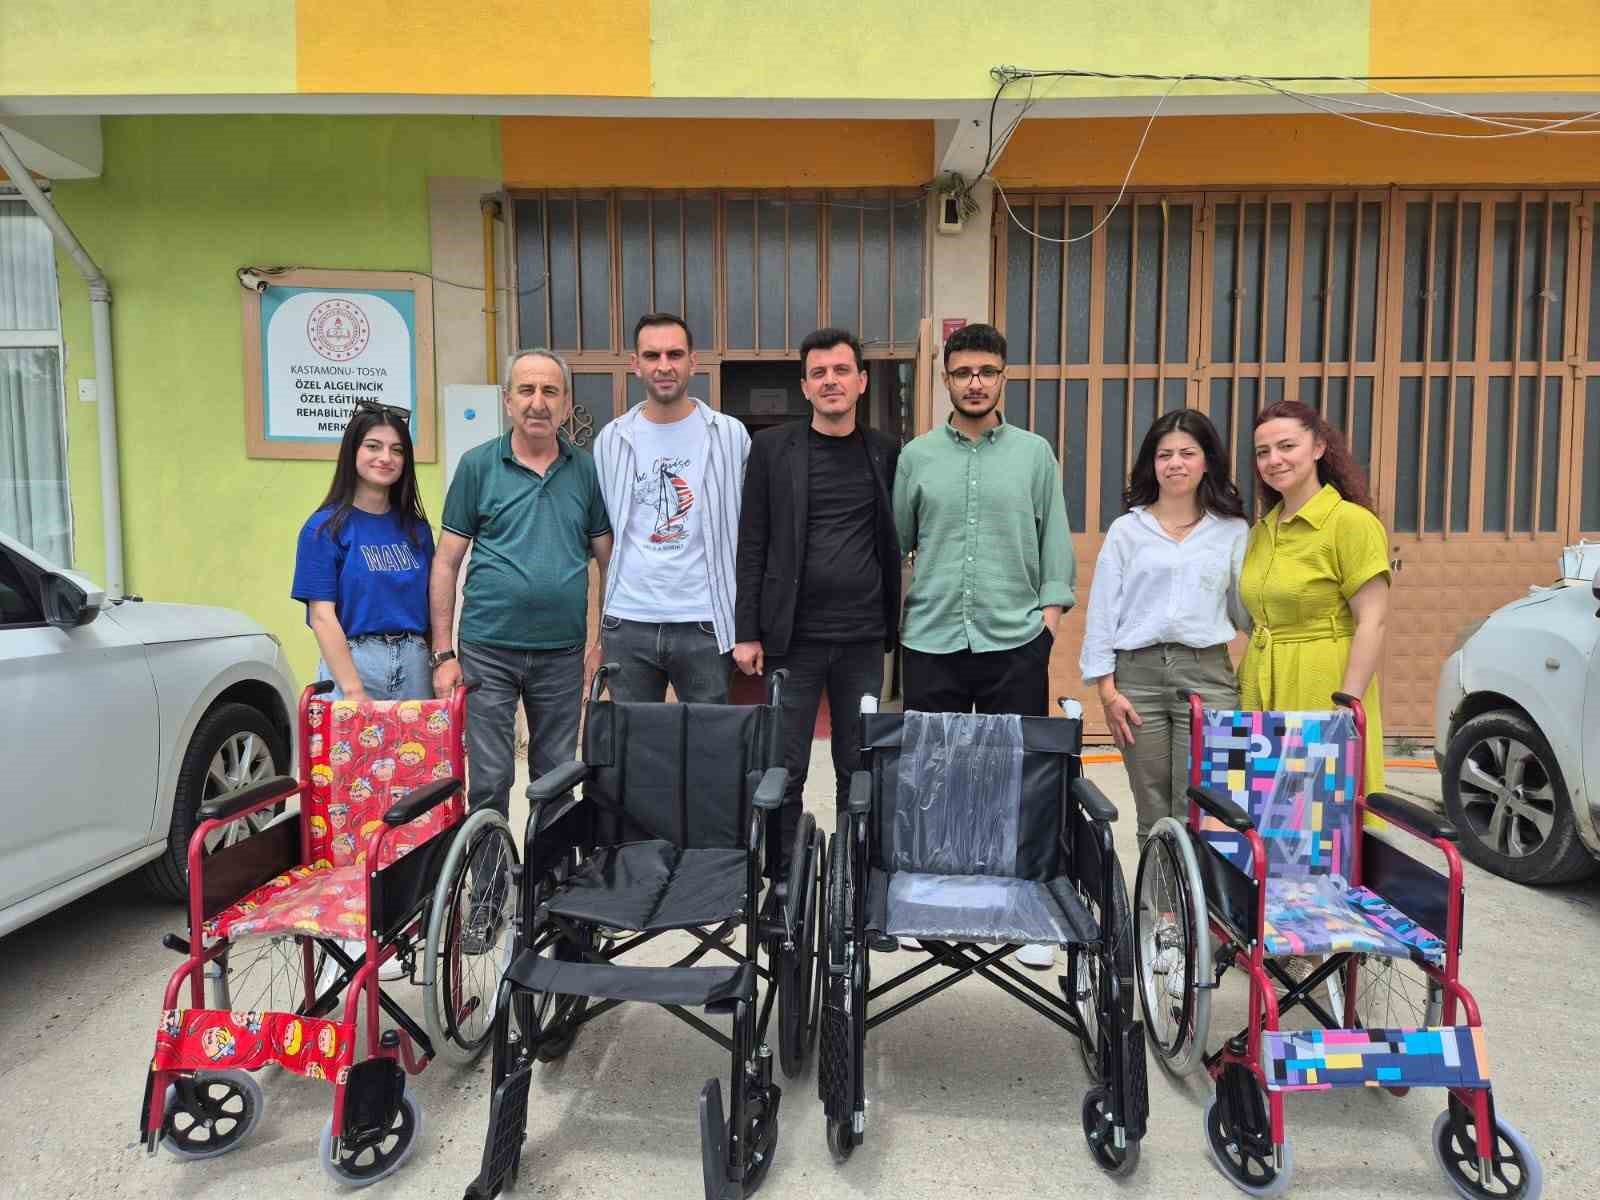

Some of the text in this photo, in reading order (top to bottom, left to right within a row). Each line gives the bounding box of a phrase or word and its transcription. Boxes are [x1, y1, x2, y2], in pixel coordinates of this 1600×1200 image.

[358, 367, 388, 377] TOSYA
[295, 379, 384, 391] ÖZEL ALGELİNCİK
[300, 392, 326, 404] ÖZEL
[296, 407, 355, 418] REHABİLİTA
[318, 422, 347, 432] MERK
